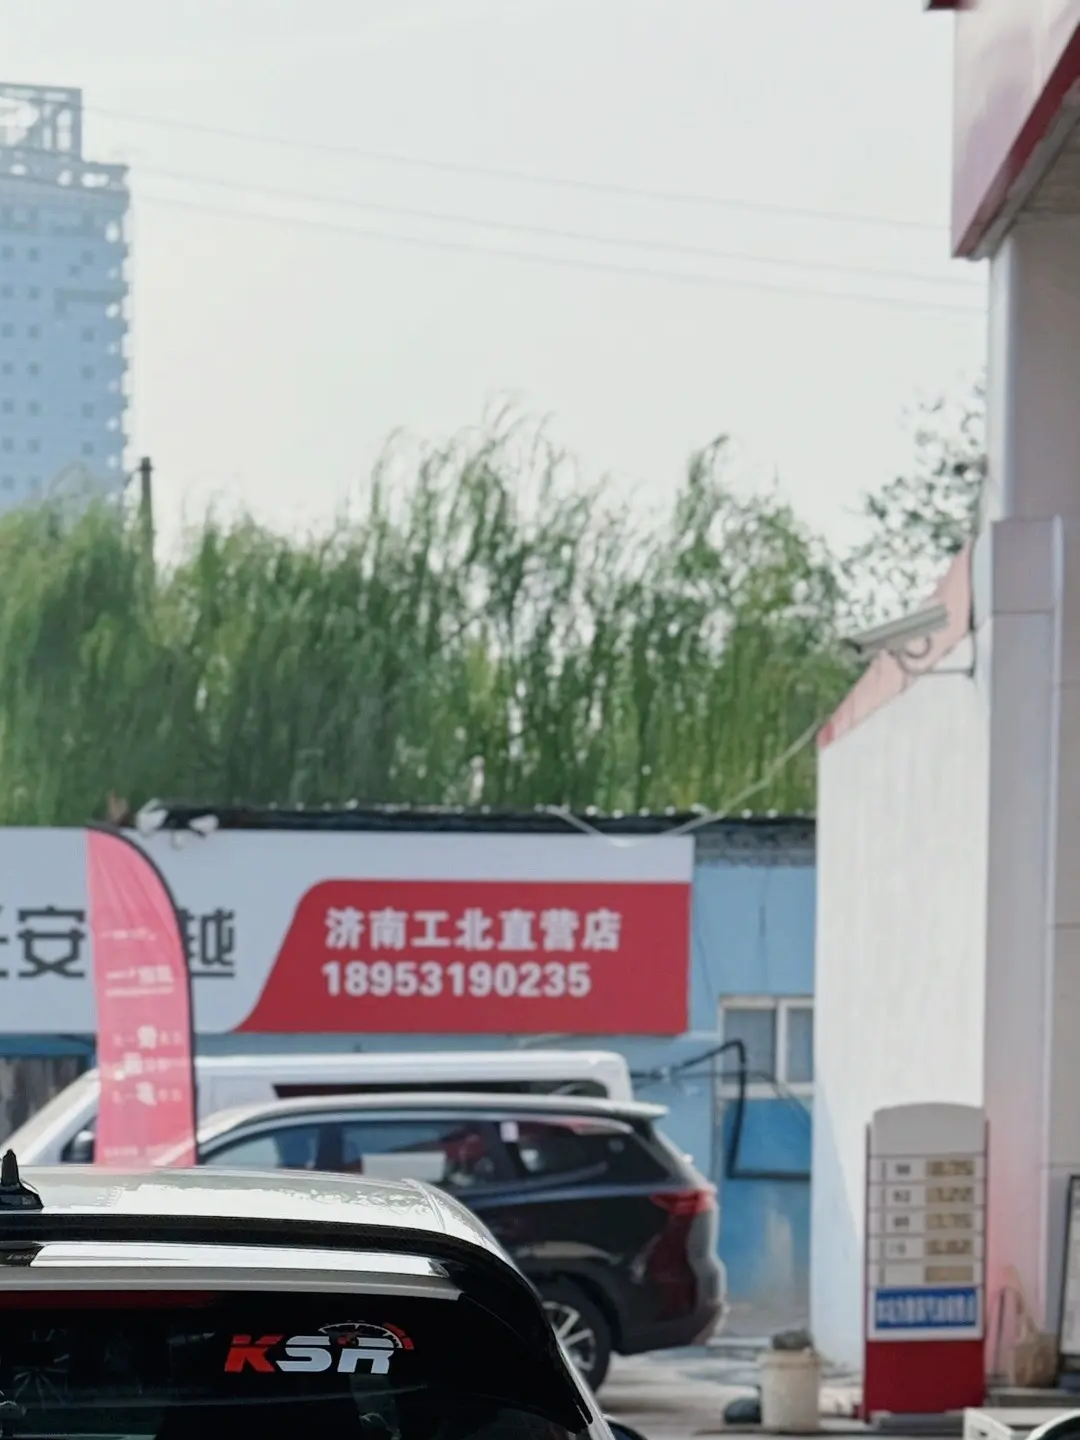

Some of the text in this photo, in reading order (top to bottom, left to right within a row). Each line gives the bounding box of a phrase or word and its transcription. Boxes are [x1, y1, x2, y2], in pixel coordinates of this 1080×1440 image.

[324, 906, 622, 951] 济南工北直营店
[322, 961, 591, 997] 18953190235
[224, 1334, 396, 1374] KSR
